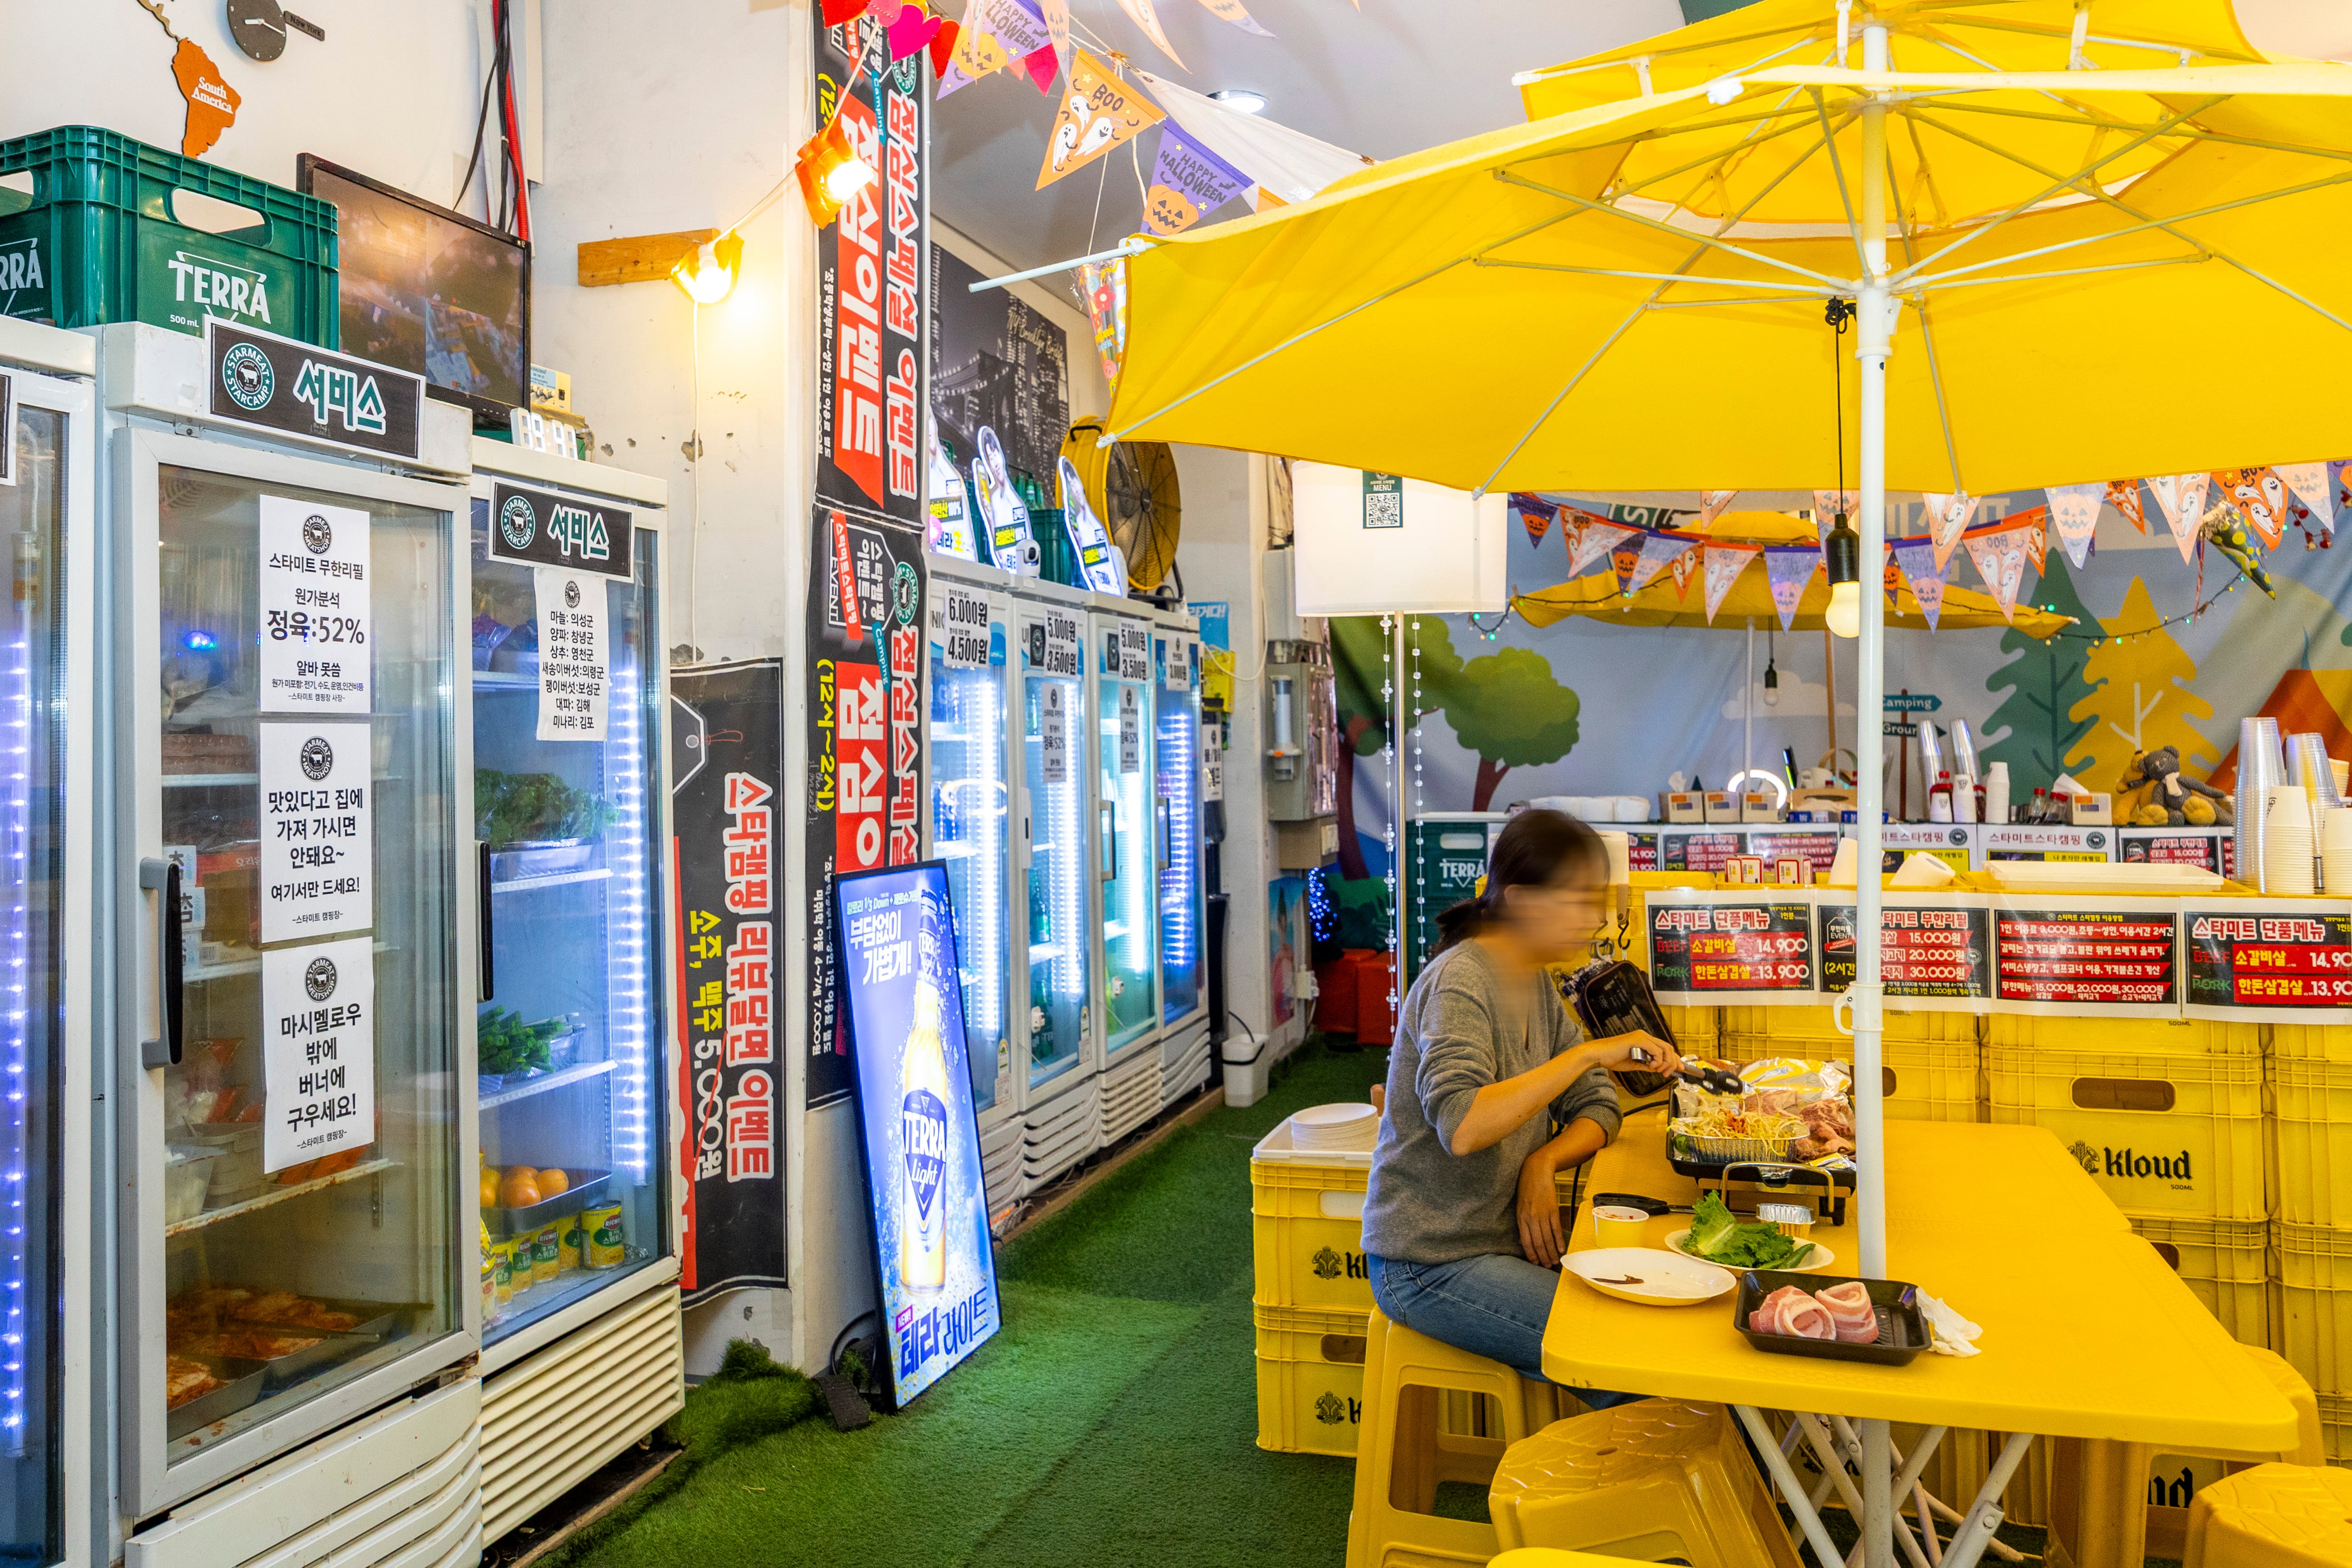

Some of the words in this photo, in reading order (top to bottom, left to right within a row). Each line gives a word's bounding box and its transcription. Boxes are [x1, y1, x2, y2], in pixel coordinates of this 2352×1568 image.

[996, 0, 1032, 28] HAPPY
[191, 86, 233, 114] America
[197, 76, 228, 100] South
[1092, 83, 1124, 112] BOO
[873, 77, 884, 138] Camping
[1160, 150, 1227, 203] HALLOWEEN
[1179, 153, 1218, 183] HAPPY
[886, 89, 919, 342] 점심스페셜
[170, 314, 186, 326] 500
[187, 316, 200, 328] mL
[228, 347, 270, 376] STARMEAT
[227, 377, 269, 406] STARCAMP
[293, 358, 386, 435] 서비스
[823, 397, 832, 432] 이용료
[886, 348, 918, 501] 이벤트
[504, 498, 533, 522] STARMEAT
[304, 515, 330, 534] STARMEAT
[504, 524, 533, 547] STARCAMP
[547, 503, 610, 560] 서비스
[304, 534, 331, 554] MEATSHOP
[269, 552, 317, 574] 스타미트
[319, 559, 364, 581] 무한리필
[835, 523, 858, 624] 스타미트스타캠핑
[829, 556, 839, 622] EVENT
[869, 541, 885, 621] 스타캠핑
[294, 587, 340, 609] 원가분석
[267, 609, 365, 645] 정육:52%
[551, 610, 569, 625] 마늘:
[570, 613, 594, 629] 의성군
[1047, 617, 1076, 643] 5.000원
[551, 627, 569, 642] 양파:
[571, 630, 594, 646] 창녕군
[550, 644, 569, 660] 상추:
[571, 647, 594, 662] 영천군
[875, 628, 891, 686] Camping
[948, 635, 988, 665] 4.500원
[1047, 650, 1076, 676] 3.500원
[296, 660, 319, 677] 알바
[321, 661, 341, 678] 못씀
[271, 678, 285, 688] 원가
[285, 679, 303, 690] 미포함:
[303, 680, 317, 691] 전기,
[317, 681, 331, 691] 수도,
[314, 692, 331, 702] 캠핑장
[556, 697, 574, 711] 대파:
[576, 699, 591, 713] 김해
[553, 715, 578, 730] 미나리:
[579, 716, 595, 730] 김포
[817, 659, 836, 812] (12시~2시)
[303, 737, 331, 757] STARMEAT
[303, 760, 331, 780] MEATSHOP
[268, 789, 331, 814] 맛있다고
[334, 788, 363, 811] 집에
[276, 818, 307, 842] 가져
[312, 815, 357, 839] 가시면
[1989, 832, 2080, 846] 스타미트스타캠핑
[722, 771, 775, 916] 스타캠핑
[290, 844, 345, 870] 안돼요~
[1439, 859, 1486, 879] TERRA
[271, 880, 319, 902] 여기서만
[322, 876, 360, 896] 드세요!
[813, 889, 824, 925] 미취학
[873, 897, 890, 910] Down
[1780, 911, 1794, 920] 1인분
[850, 909, 902, 950] 부담없이
[1655, 910, 1711, 930] 스타미트
[1713, 908, 1770, 930] 단품메뉴
[1881, 910, 1918, 927] 타미트
[1921, 911, 1968, 929] 무한리필
[2000, 925, 2012, 935] 1인
[2014, 925, 2038, 935] 이용료
[2153, 927, 2174, 937] 2시간
[2080, 914, 2101, 922] 스타캠핑
[2102, 914, 2123, 922] 이용방법
[2192, 917, 2257, 941] 스타미트
[2260, 918, 2325, 942] 단품메뉴
[688, 909, 723, 970] 소주,
[813, 928, 824, 953] 아동
[1657, 939, 1688, 953] BEEF
[1691, 939, 1736, 954] 소갈비살
[1756, 937, 1808, 954] 14.900
[1909, 932, 1961, 945] 15.000원
[2095, 945, 2112, 955] 위에
[2114, 946, 2137, 956] 쓰레기
[307, 957, 334, 979] STARMEAT
[862, 940, 912, 986] 가볍게!
[1909, 949, 1965, 963] 20.000원
[2052, 963, 2083, 974] 셀프코너
[2144, 965, 2160, 975] 계산
[2193, 950, 2230, 964] BEEF
[2235, 950, 2287, 967] 소갈비살
[812, 956, 822, 997] 4~7세
[1656, 966, 1690, 978] PORK
[1695, 965, 1751, 981] 한돈삼겹살
[1757, 964, 1810, 980] 13.900
[1910, 967, 1965, 980] 30.000원
[2192, 978, 2232, 991] PORK
[307, 981, 335, 1000] MEATSHOP
[725, 921, 775, 1068] 리뷰달면
[2238, 978, 2303, 996] 한돈삼겹살
[690, 980, 723, 1034] 맥주
[823, 990, 834, 1026] 이용료
[281, 1002, 362, 1039] 마시멜로우
[812, 999, 822, 1056] 7.000원
[306, 1036, 337, 1066] 밖에
[299, 1065, 346, 1097] 버너에
[287, 1093, 357, 1132] 구우세요!
[725, 1069, 775, 1184] 이벤트
[903, 1110, 946, 1163] TERRA
[901, 1306, 940, 1380] 테라
[943, 1287, 988, 1357] 라이트
